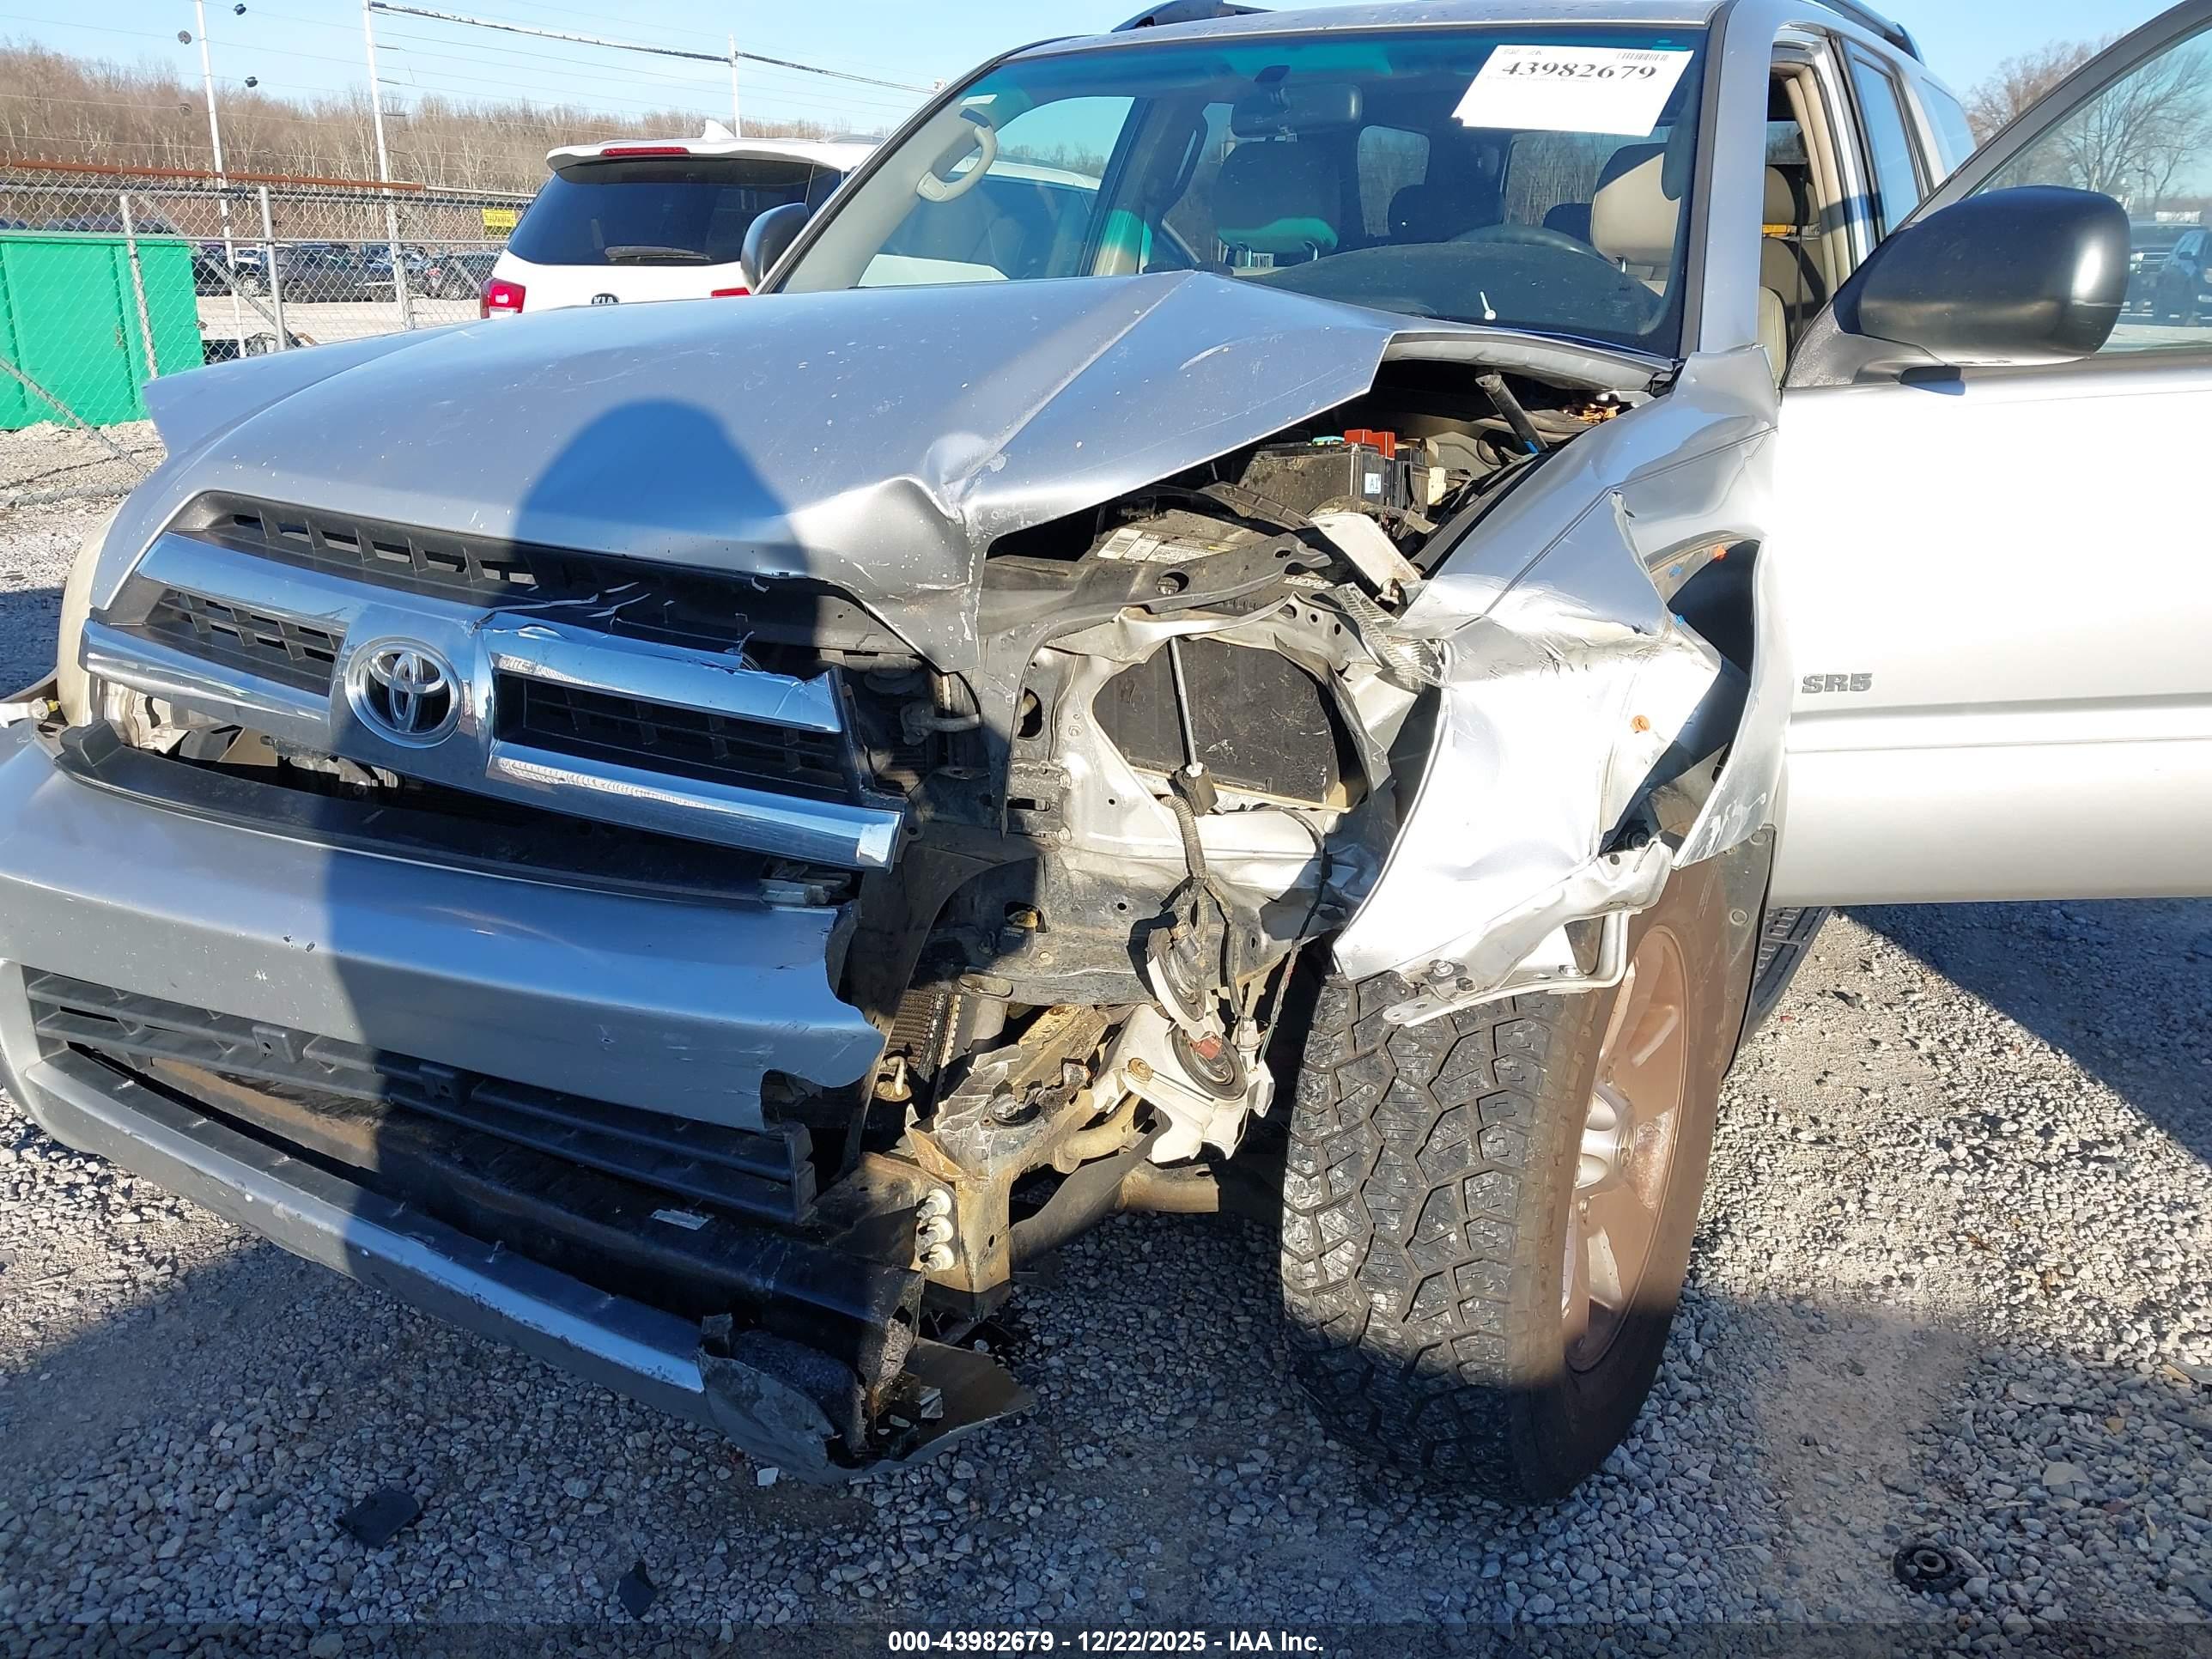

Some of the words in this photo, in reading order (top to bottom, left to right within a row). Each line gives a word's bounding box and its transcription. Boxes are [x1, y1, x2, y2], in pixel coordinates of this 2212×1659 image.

[1502, 61, 1657, 81] 43982679
[593, 296, 615, 306] KIA
[1802, 672, 1873, 694] SR5
